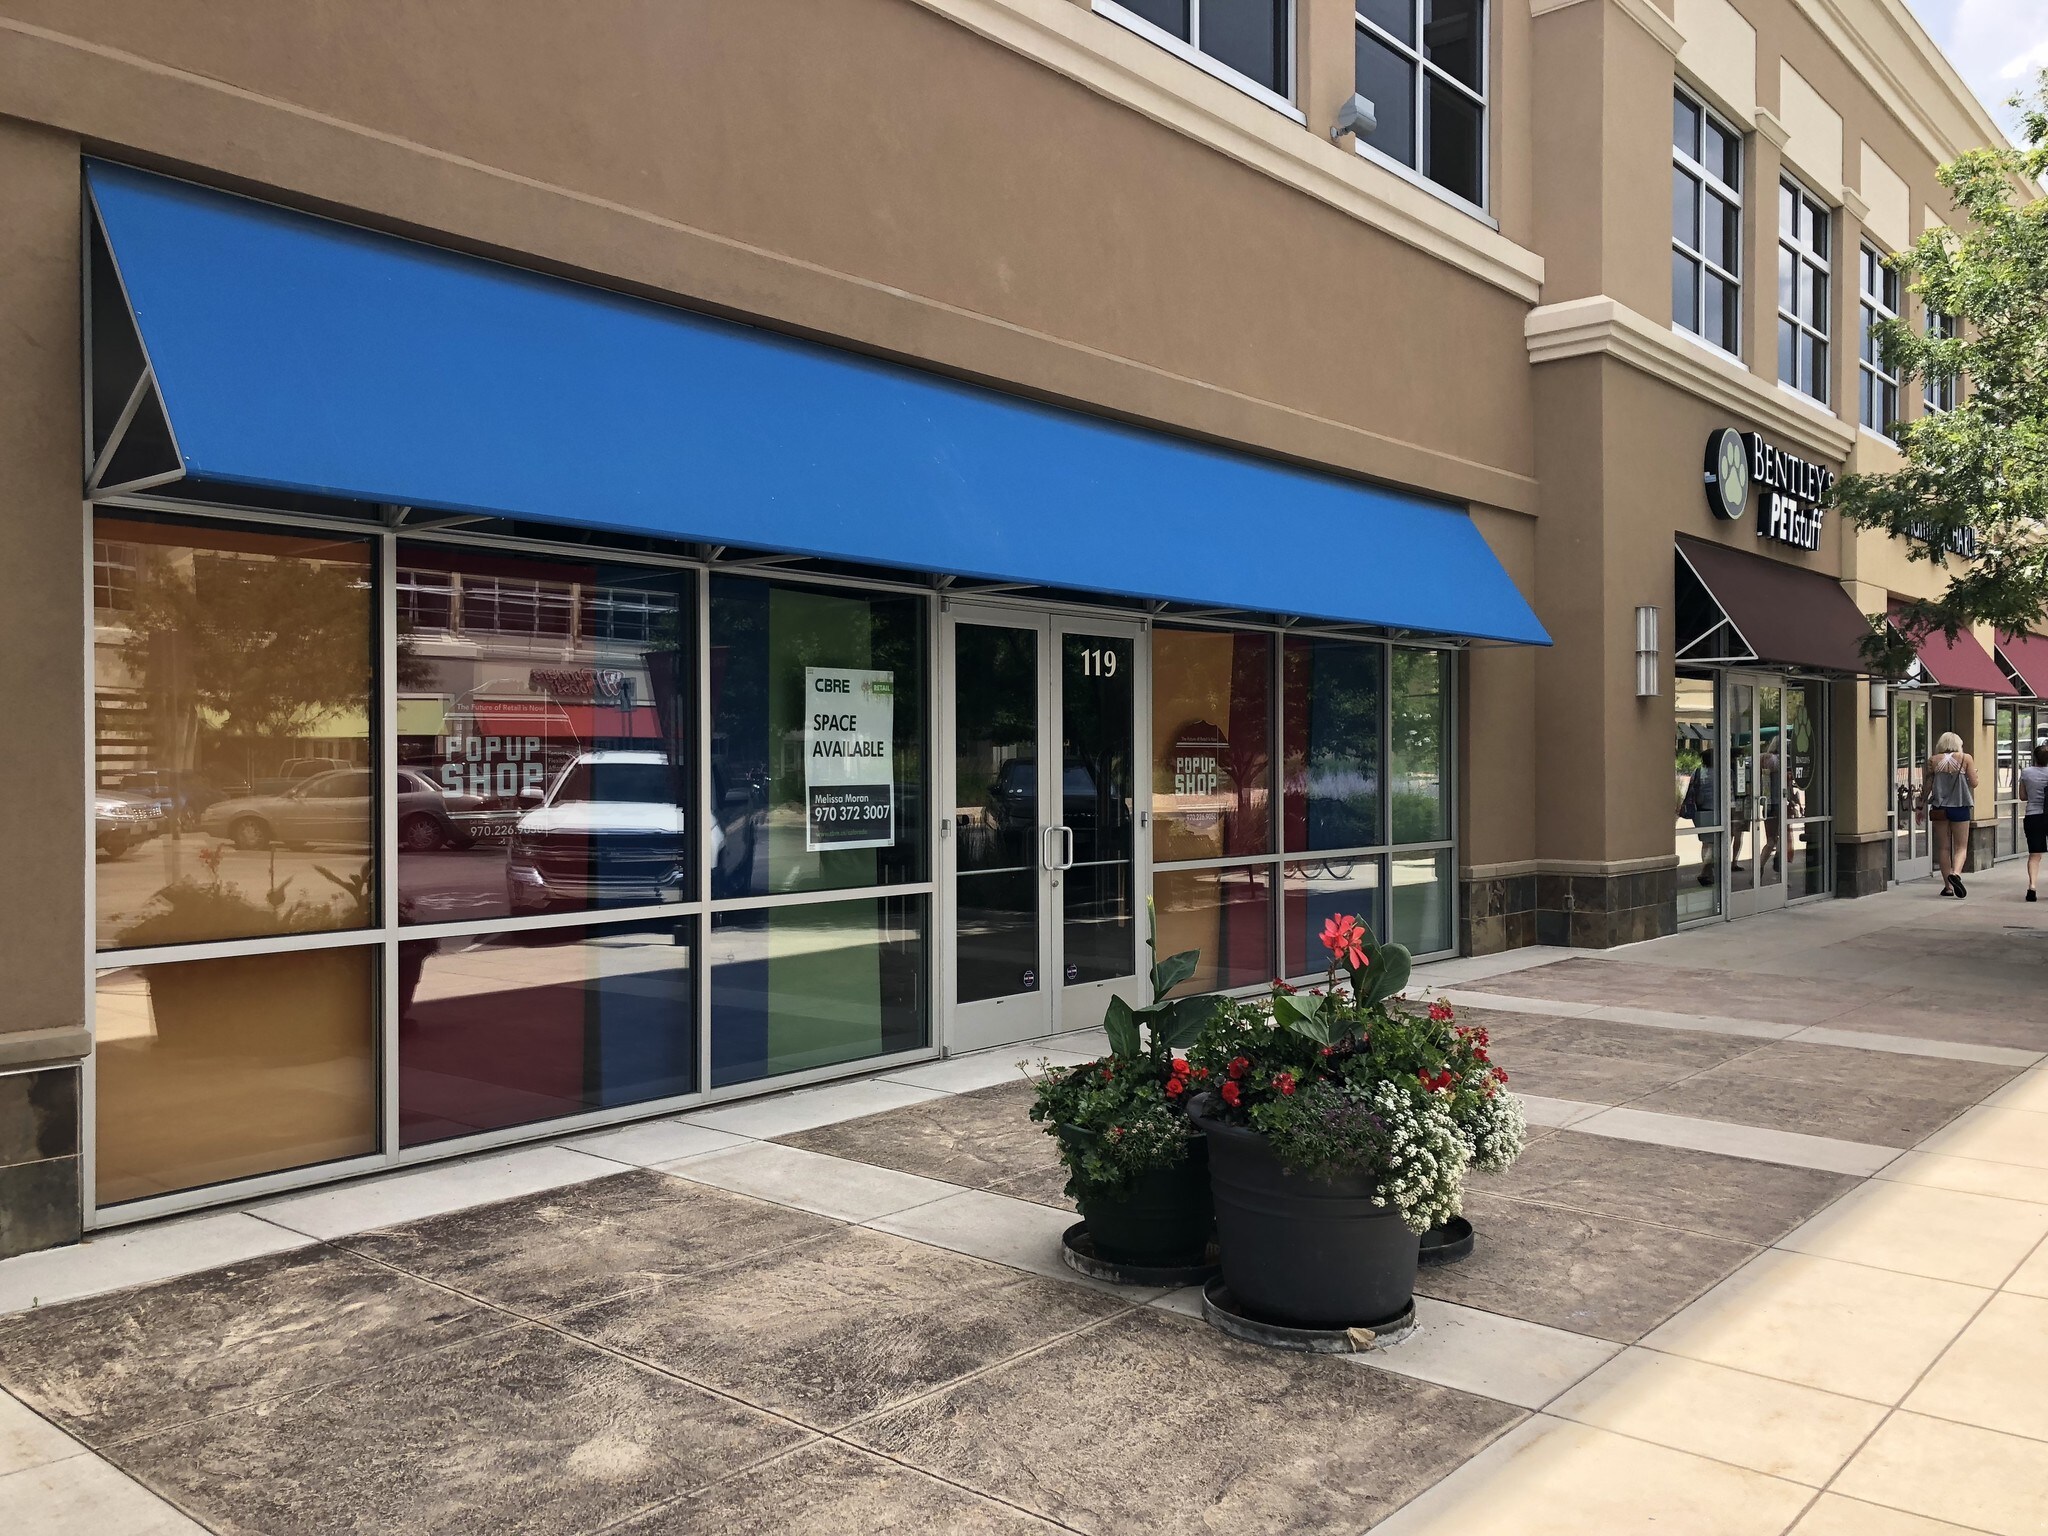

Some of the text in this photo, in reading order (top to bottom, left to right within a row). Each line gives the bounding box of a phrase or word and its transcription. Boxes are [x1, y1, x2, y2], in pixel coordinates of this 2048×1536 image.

[1770, 492, 1823, 551] PETstuff
[1081, 649, 1117, 677] 119
[815, 678, 850, 693] CBRE
[457, 703, 469, 711] The
[471, 703, 493, 711] Future
[494, 703, 501, 711] of
[503, 704, 522, 712] Retail
[813, 714, 857, 731] SPACE
[445, 736, 540, 762] POPUP
[813, 741, 884, 758] AVAILABLE
[1176, 757, 1216, 773] POPUP
[441, 762, 544, 798] SHOP
[1175, 774, 1217, 796] SHOP
[815, 794, 869, 804] Melissa Moran
[815, 805, 890, 822] 970 372 3007
